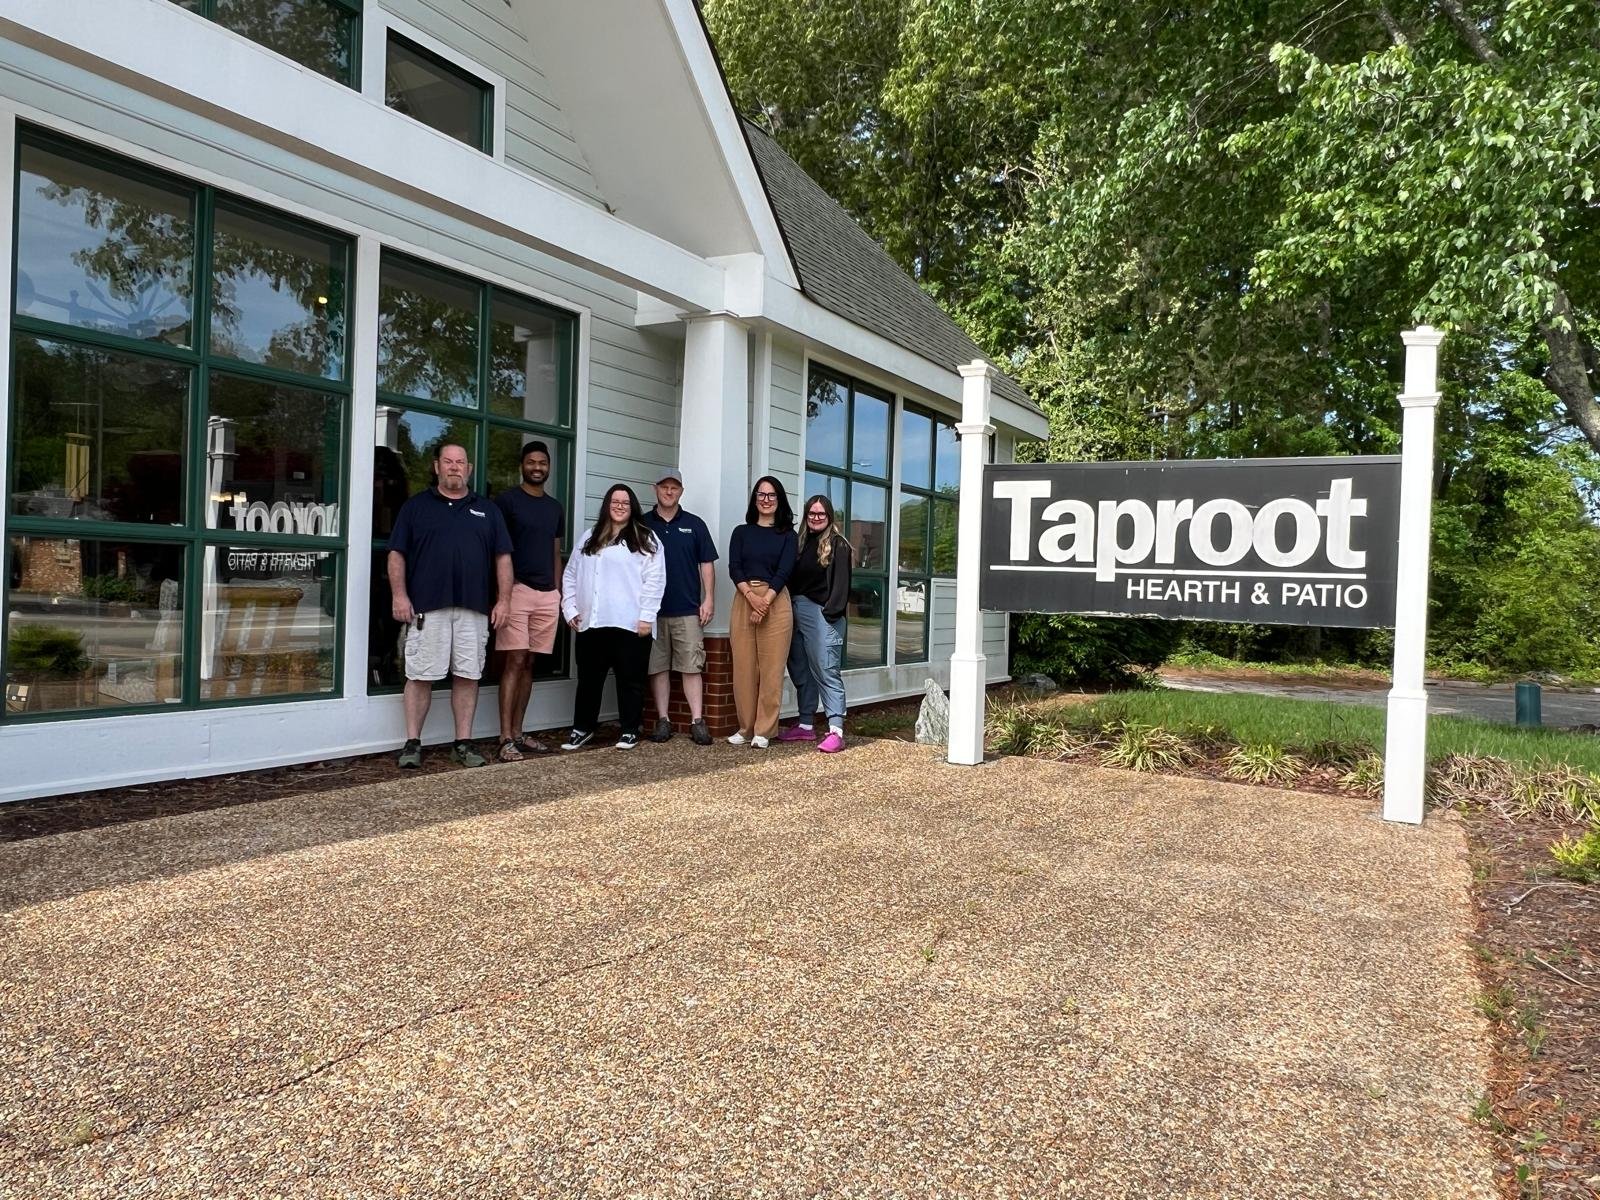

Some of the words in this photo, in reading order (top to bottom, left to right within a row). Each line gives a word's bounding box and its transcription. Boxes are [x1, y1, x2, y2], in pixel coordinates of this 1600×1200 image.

[993, 478, 1367, 582] Taproot
[1126, 578, 1240, 603] HEARTH
[1250, 582, 1270, 605] &
[1281, 583, 1368, 608] PATIO
